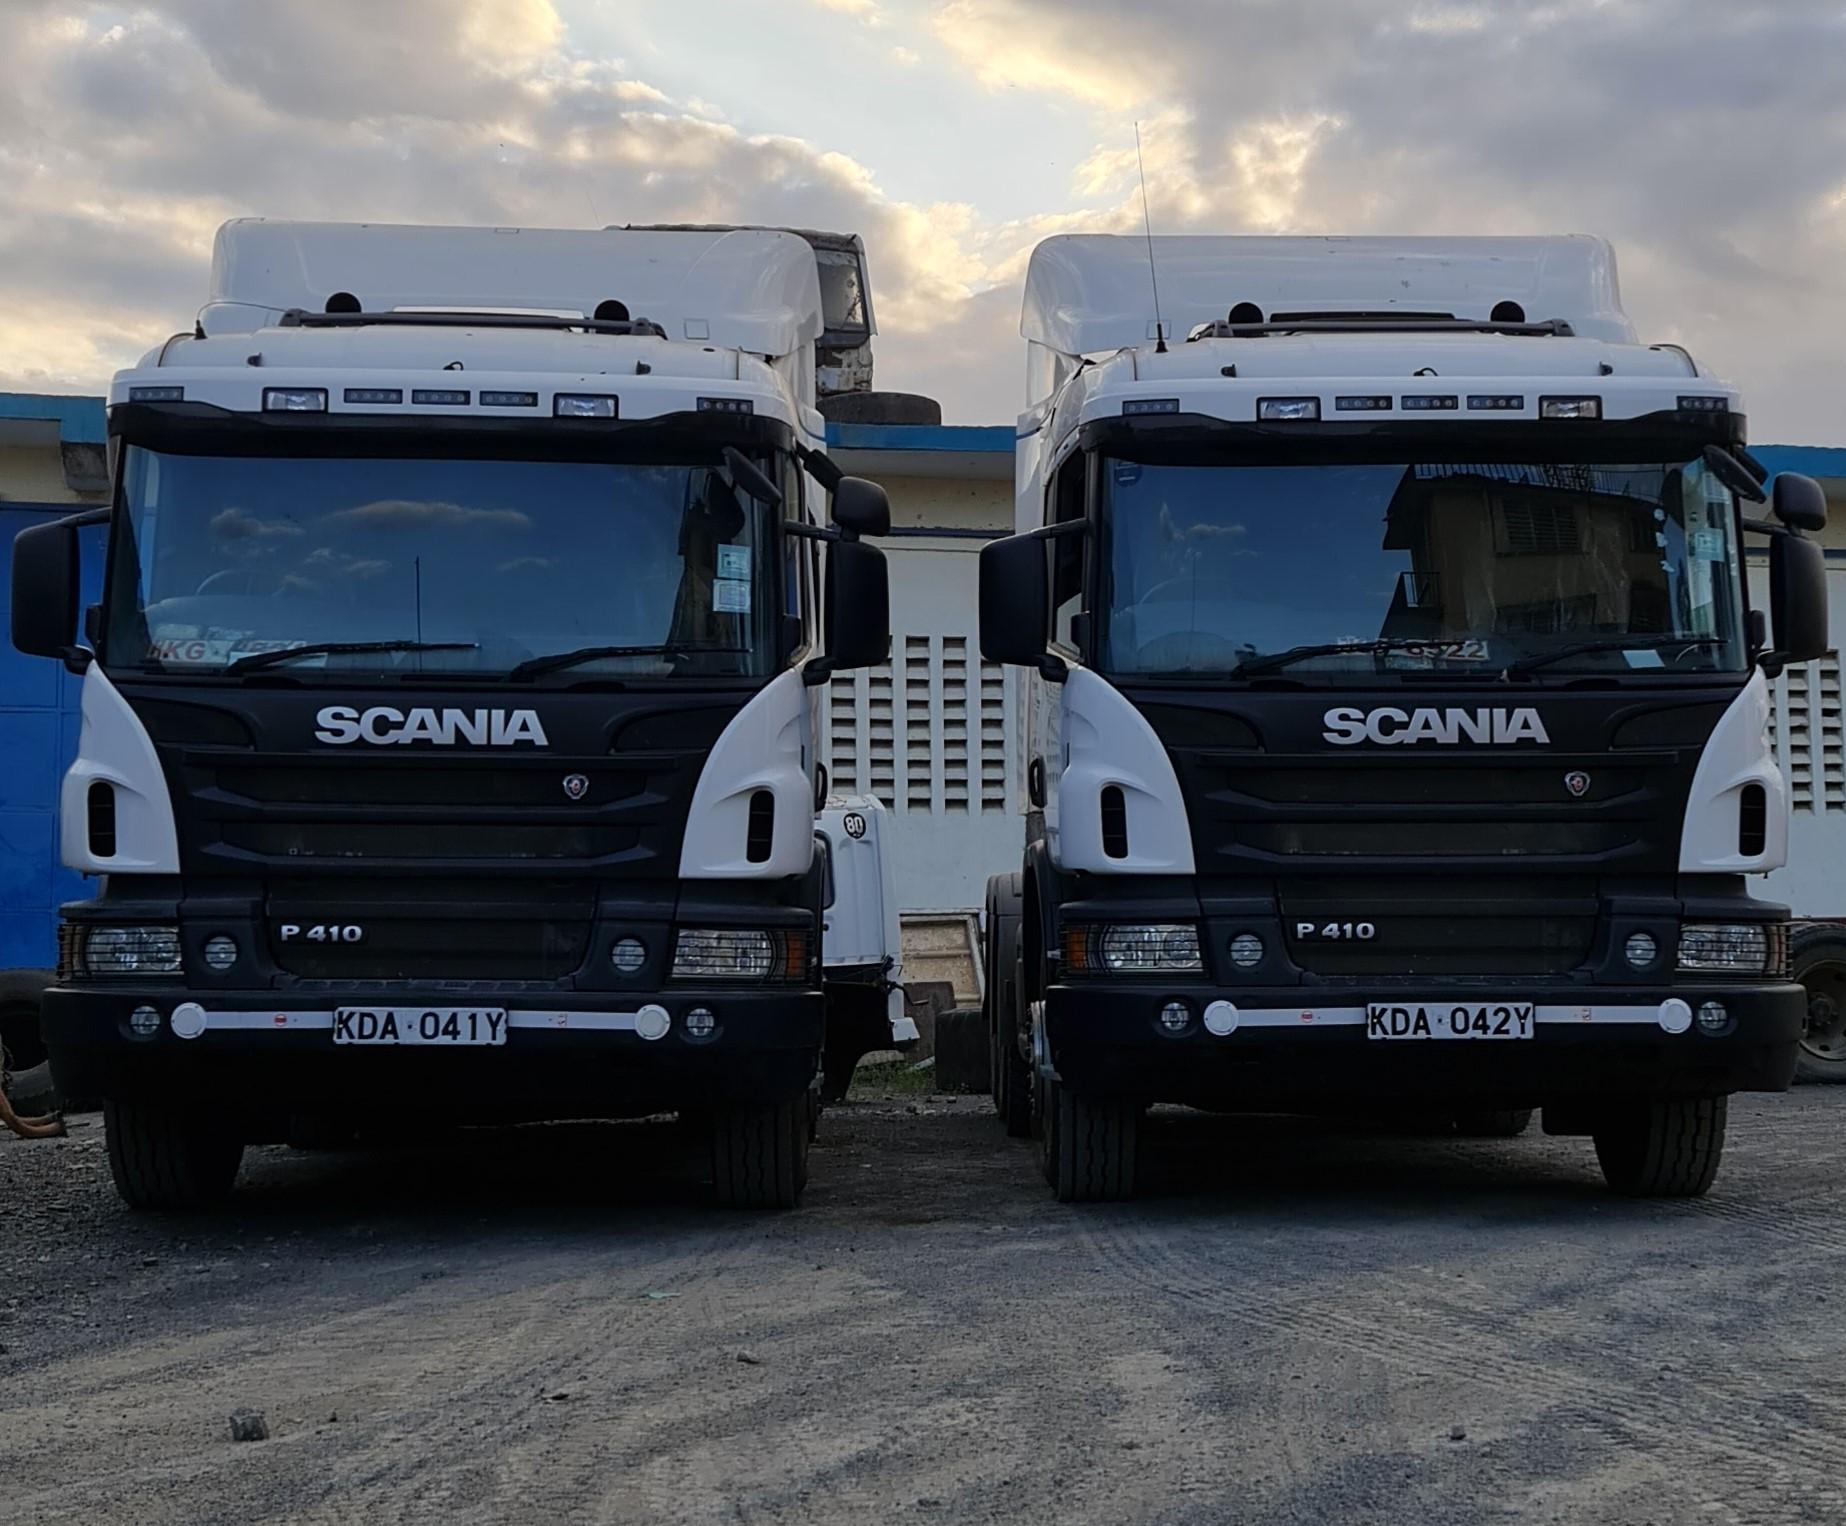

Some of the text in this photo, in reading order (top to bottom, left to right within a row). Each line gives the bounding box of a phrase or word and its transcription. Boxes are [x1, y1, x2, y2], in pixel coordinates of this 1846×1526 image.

[314, 706, 549, 747] SCANIA
[1322, 706, 1551, 746] SCANIA
[845, 816, 863, 833] 80
[280, 924, 363, 943] P 410
[1296, 922, 1376, 940] P 410
[335, 1011, 504, 1041] KDA 041Y
[1370, 1006, 1532, 1036] KDA 042Y
